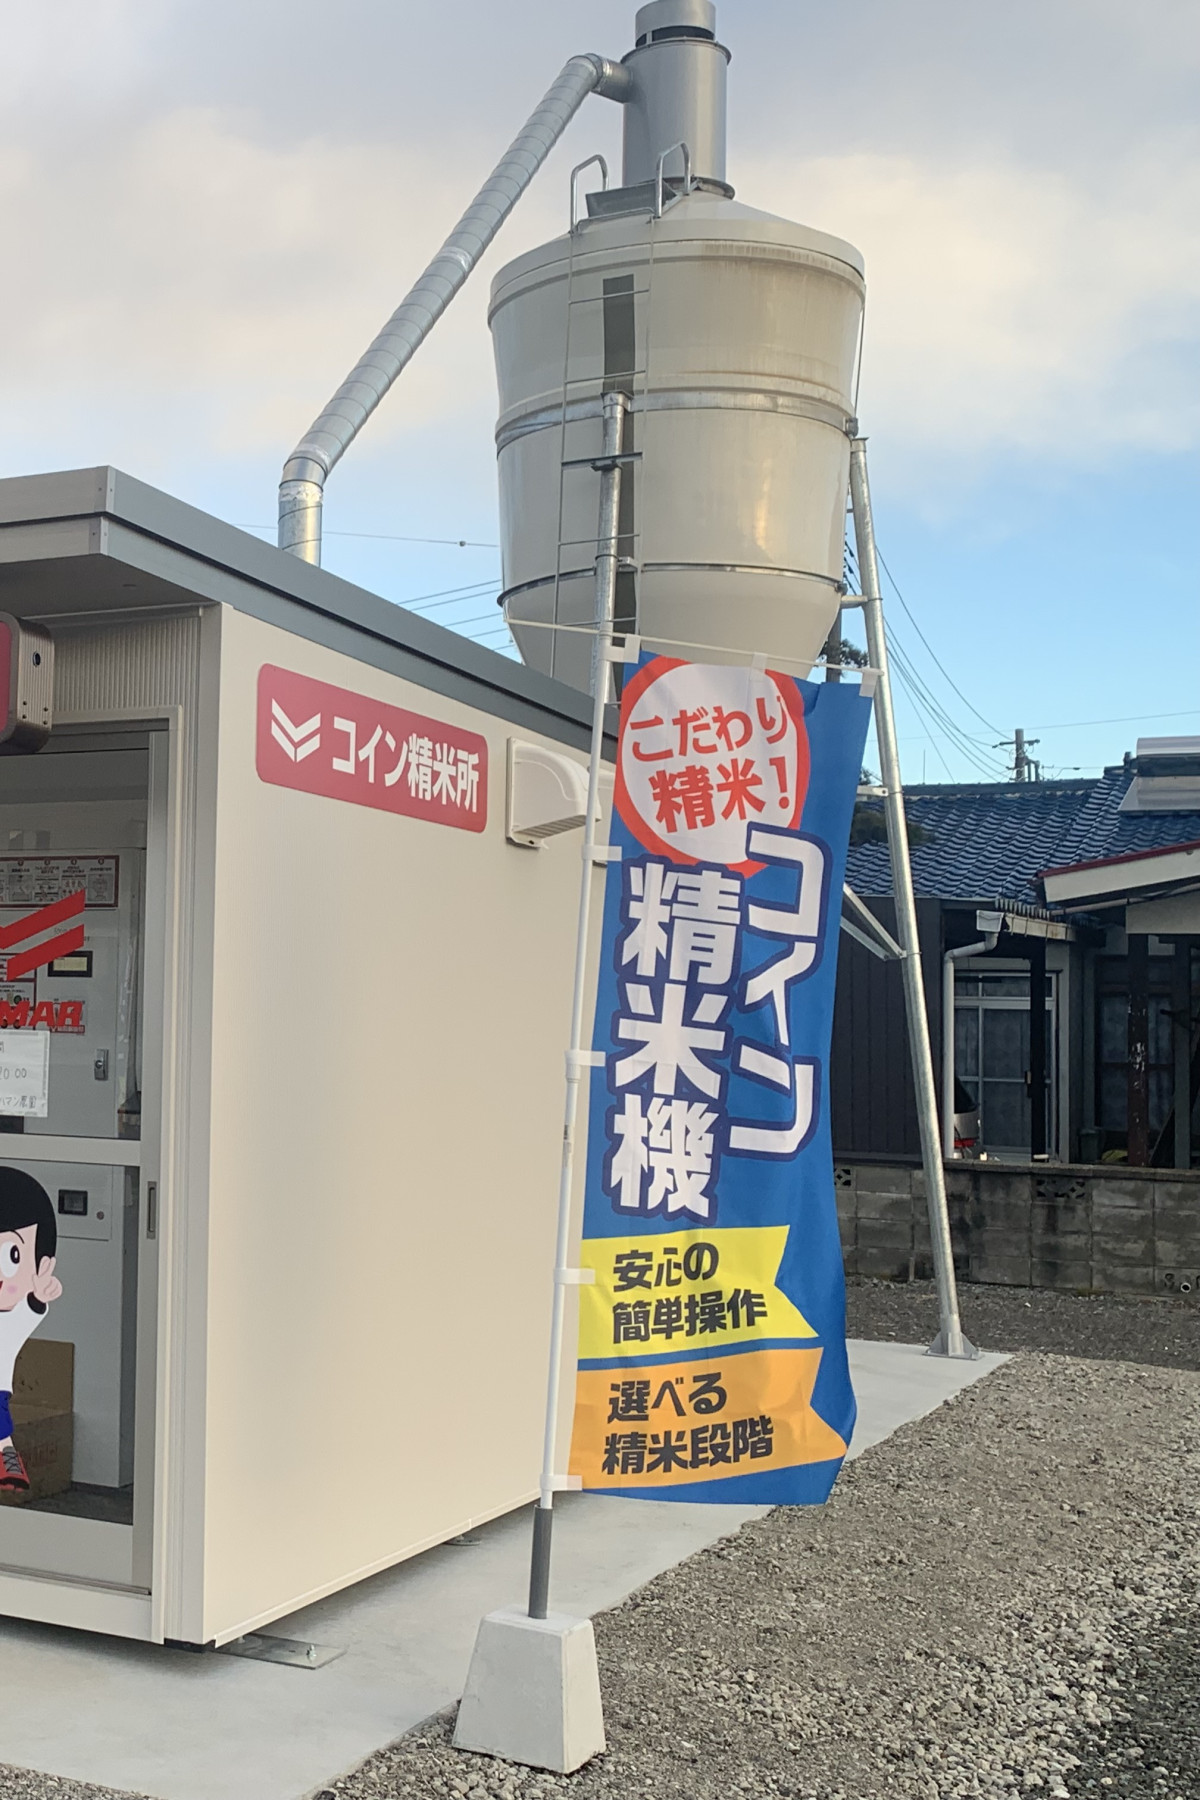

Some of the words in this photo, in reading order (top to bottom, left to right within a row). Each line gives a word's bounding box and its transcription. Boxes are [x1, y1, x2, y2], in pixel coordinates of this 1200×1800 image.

[629, 695, 789, 763] こだわり
[332, 715, 480, 813] コイン精米所
[648, 756, 790, 834] 精米!
[727, 827, 825, 1154] コイン
[609, 861, 742, 1219] 精米機
[612, 1241, 720, 1293] 安心の
[611, 1287, 769, 1344] 簡単操作
[606, 1371, 728, 1425] 選べる
[600, 1414, 774, 1476] 精米段階
